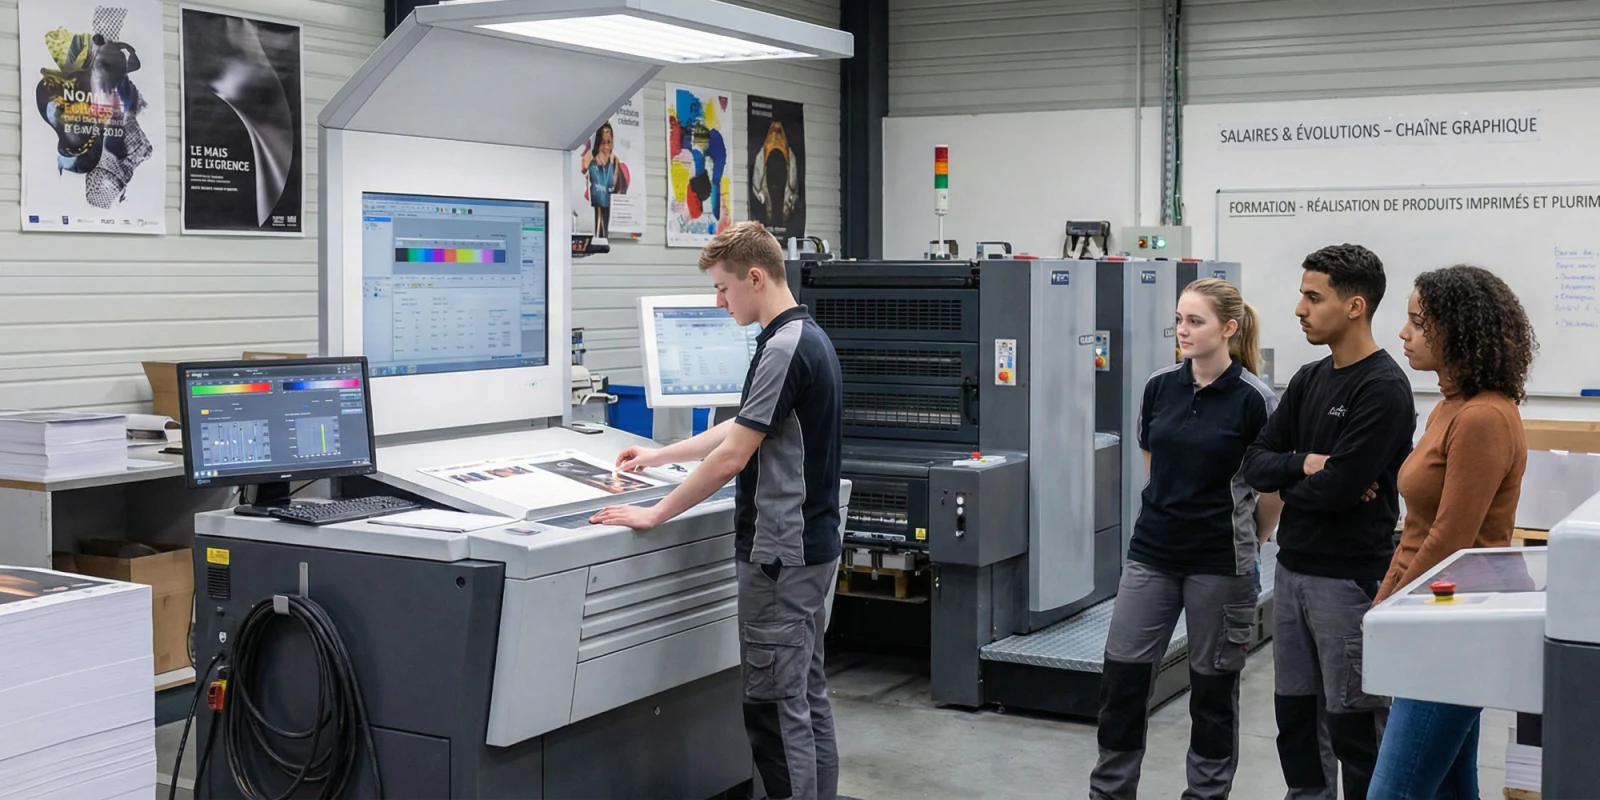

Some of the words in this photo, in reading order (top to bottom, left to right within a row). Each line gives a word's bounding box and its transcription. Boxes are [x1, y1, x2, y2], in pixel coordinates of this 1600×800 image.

[102, 127, 124, 138] 2010
[1220, 126, 1279, 144] SALAIRES
[1283, 126, 1293, 141] &
[1296, 121, 1381, 141] ÉVOLUTIONS
[1395, 117, 1448, 138] CHAÎNE
[1452, 117, 1537, 136] GRAPHIQUE
[190, 145, 202, 156] LE
[203, 146, 228, 158] MAIS
[190, 158, 203, 169] DE
[1229, 200, 1296, 214] FORMATION
[1307, 196, 1380, 213] RÉALISATION
[1383, 198, 1399, 212] DE
[1402, 197, 1463, 211] PRODUITS
[1466, 193, 1530, 210] IMPRIMÉS
[1533, 196, 1548, 209] ET
[1551, 195, 1600, 209] PLURIM
